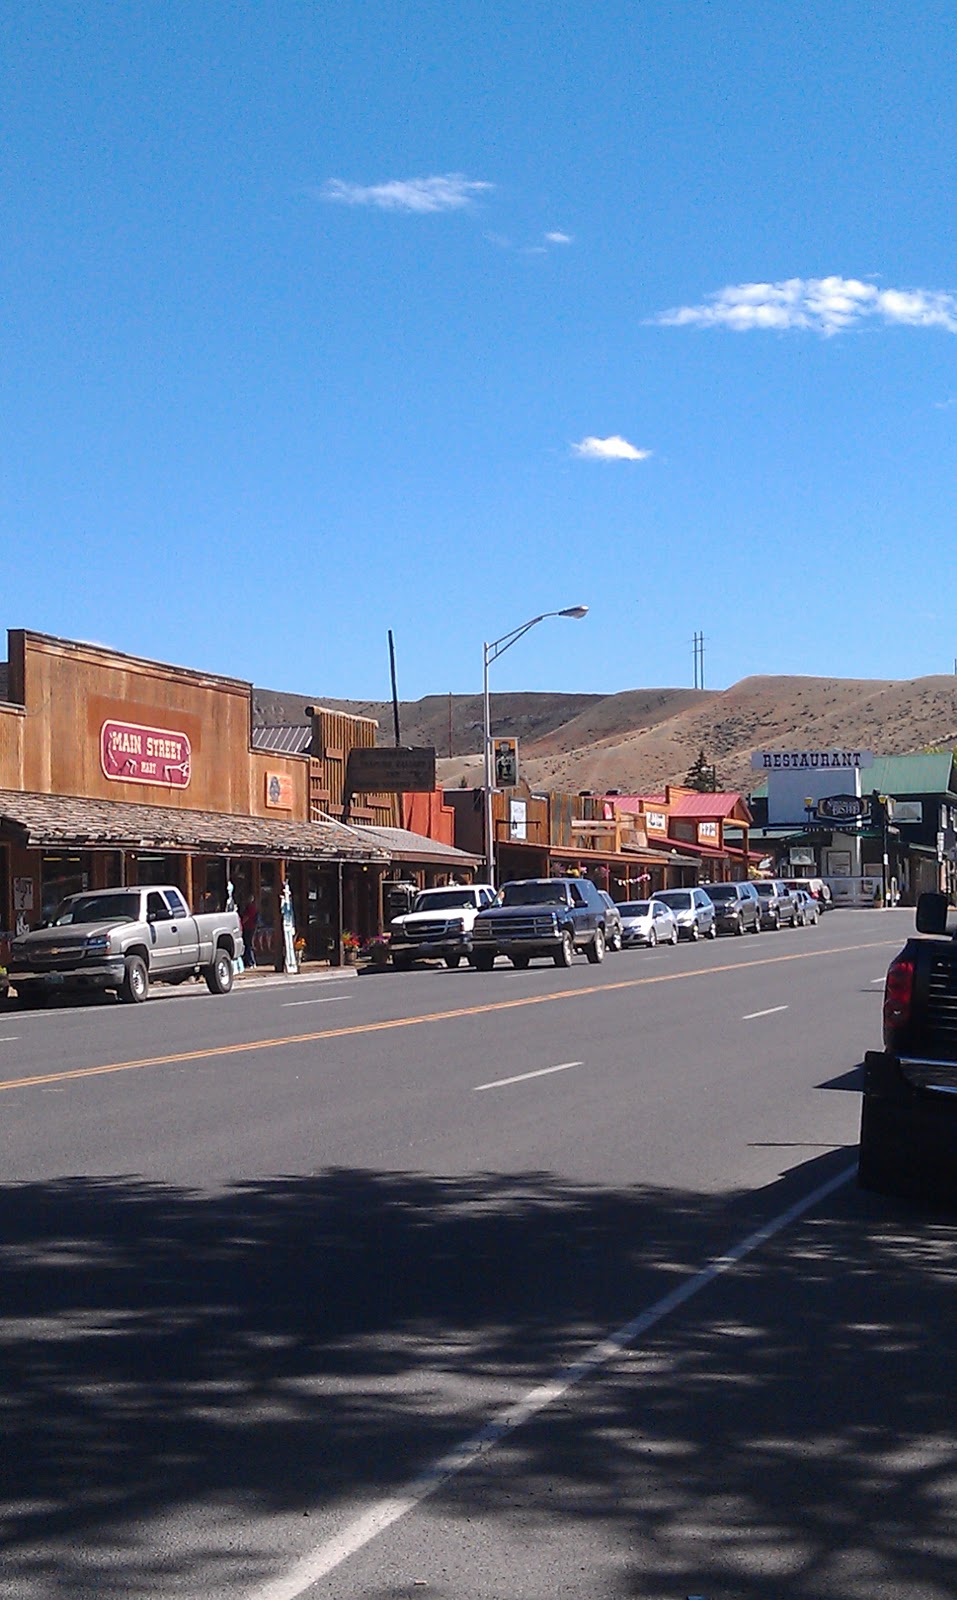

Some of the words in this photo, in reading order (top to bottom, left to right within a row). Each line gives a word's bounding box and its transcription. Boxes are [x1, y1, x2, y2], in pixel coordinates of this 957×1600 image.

[112, 731, 142, 755] MAIN
[146, 736, 182, 761] STREET
[763, 752, 861, 768] RESTAURANT
